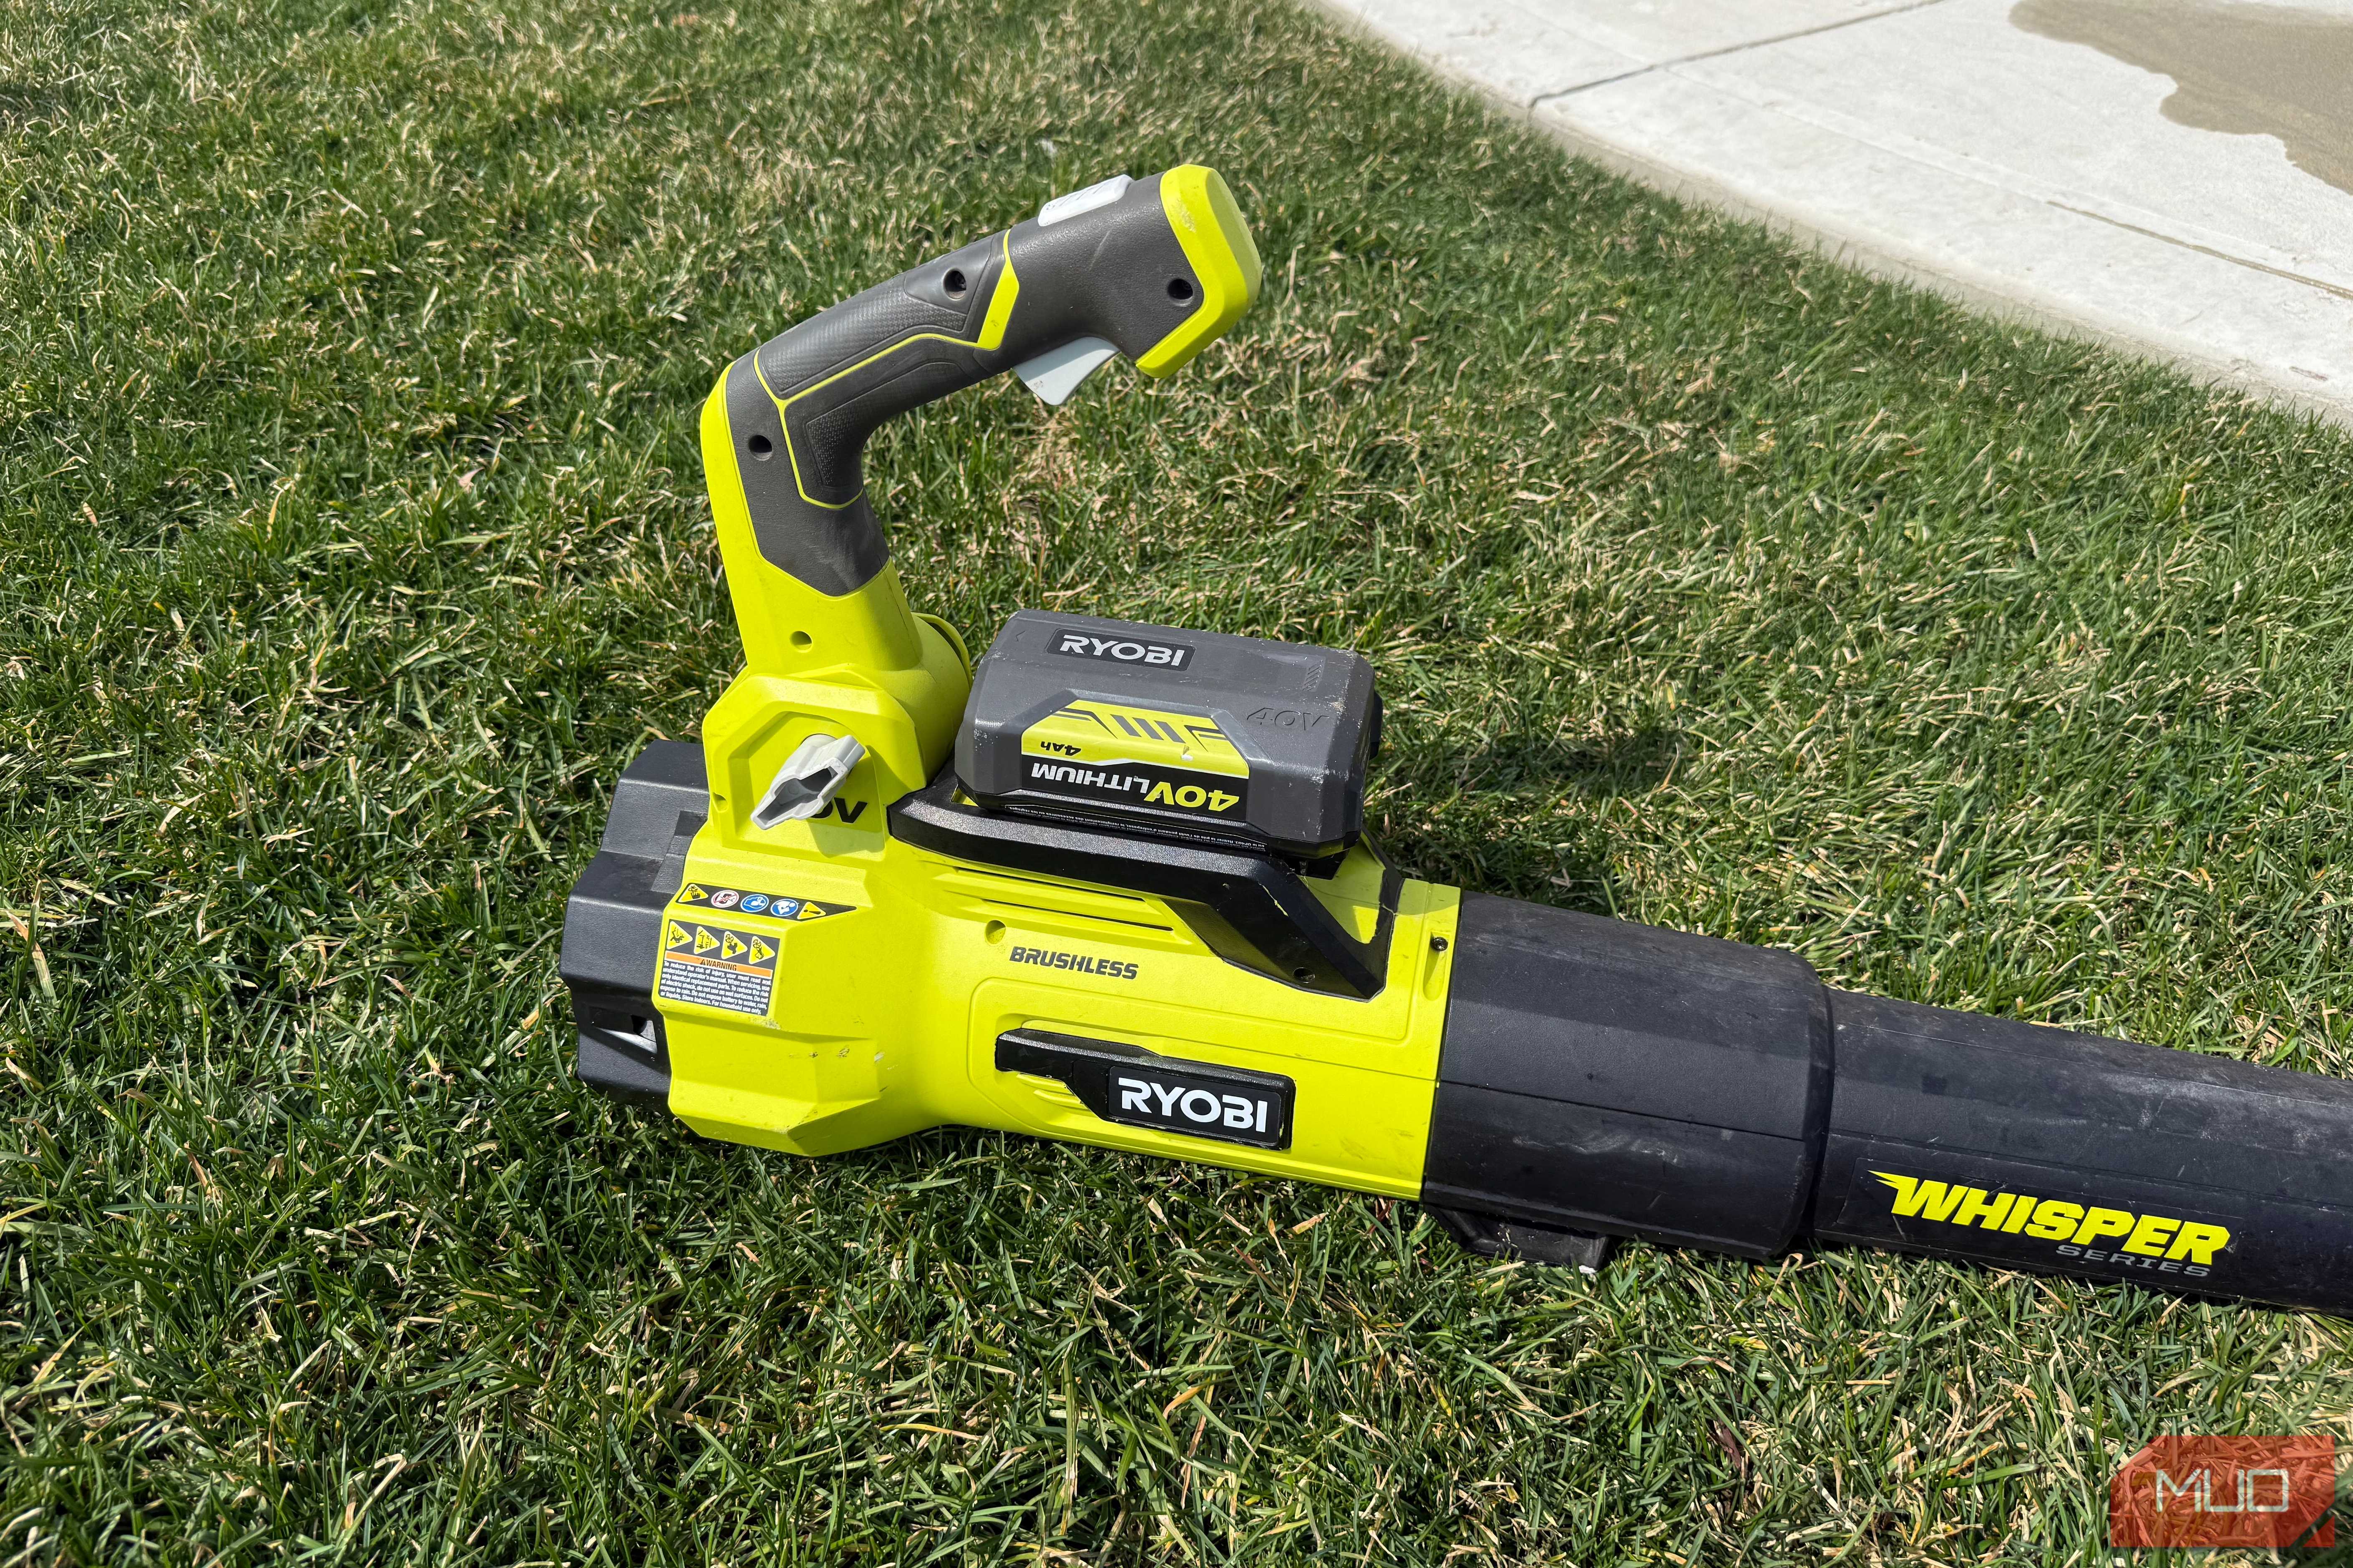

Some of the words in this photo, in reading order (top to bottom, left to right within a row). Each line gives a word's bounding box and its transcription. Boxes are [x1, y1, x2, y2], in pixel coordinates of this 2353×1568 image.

[1060, 635, 1185, 666] RYOBI
[1247, 708, 1329, 731] 40V
[1041, 741, 1081, 756] 4Ah
[663, 967, 687, 976] understand
[706, 959, 737, 971] WARNING
[1009, 946, 1139, 980] BRUSHLESS
[672, 974, 690, 983] identical
[691, 978, 718, 988] replacement
[720, 1001, 742, 1010] household
[722, 995, 738, 1004] battery
[1119, 1077, 1268, 1132] RYOBI
[1867, 1170, 2230, 1265] WHISPER
[2056, 1244, 2211, 1277] SERIES
